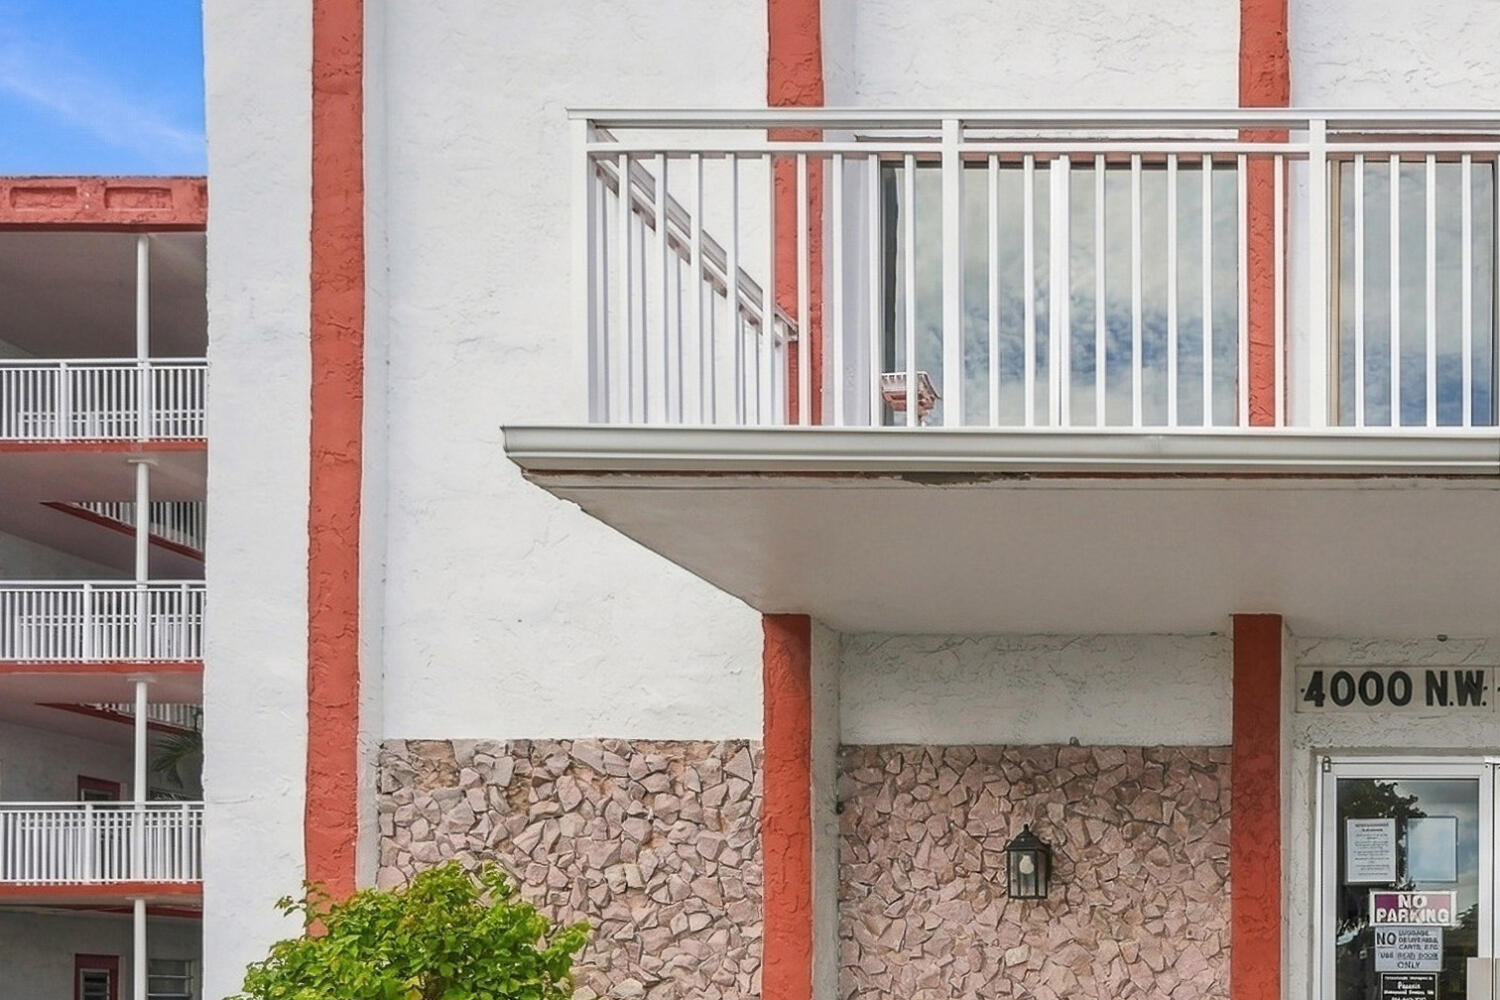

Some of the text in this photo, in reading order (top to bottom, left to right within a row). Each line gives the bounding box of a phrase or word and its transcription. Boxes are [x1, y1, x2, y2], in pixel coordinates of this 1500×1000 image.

[1303, 670, 1413, 708] 4000
[1425, 670, 1487, 707] N.W.
[1398, 894, 1427, 908] NO
[1376, 908, 1449, 922] PARKING
[1376, 932, 1397, 946] NO
[1397, 961, 1421, 969] ONLY
